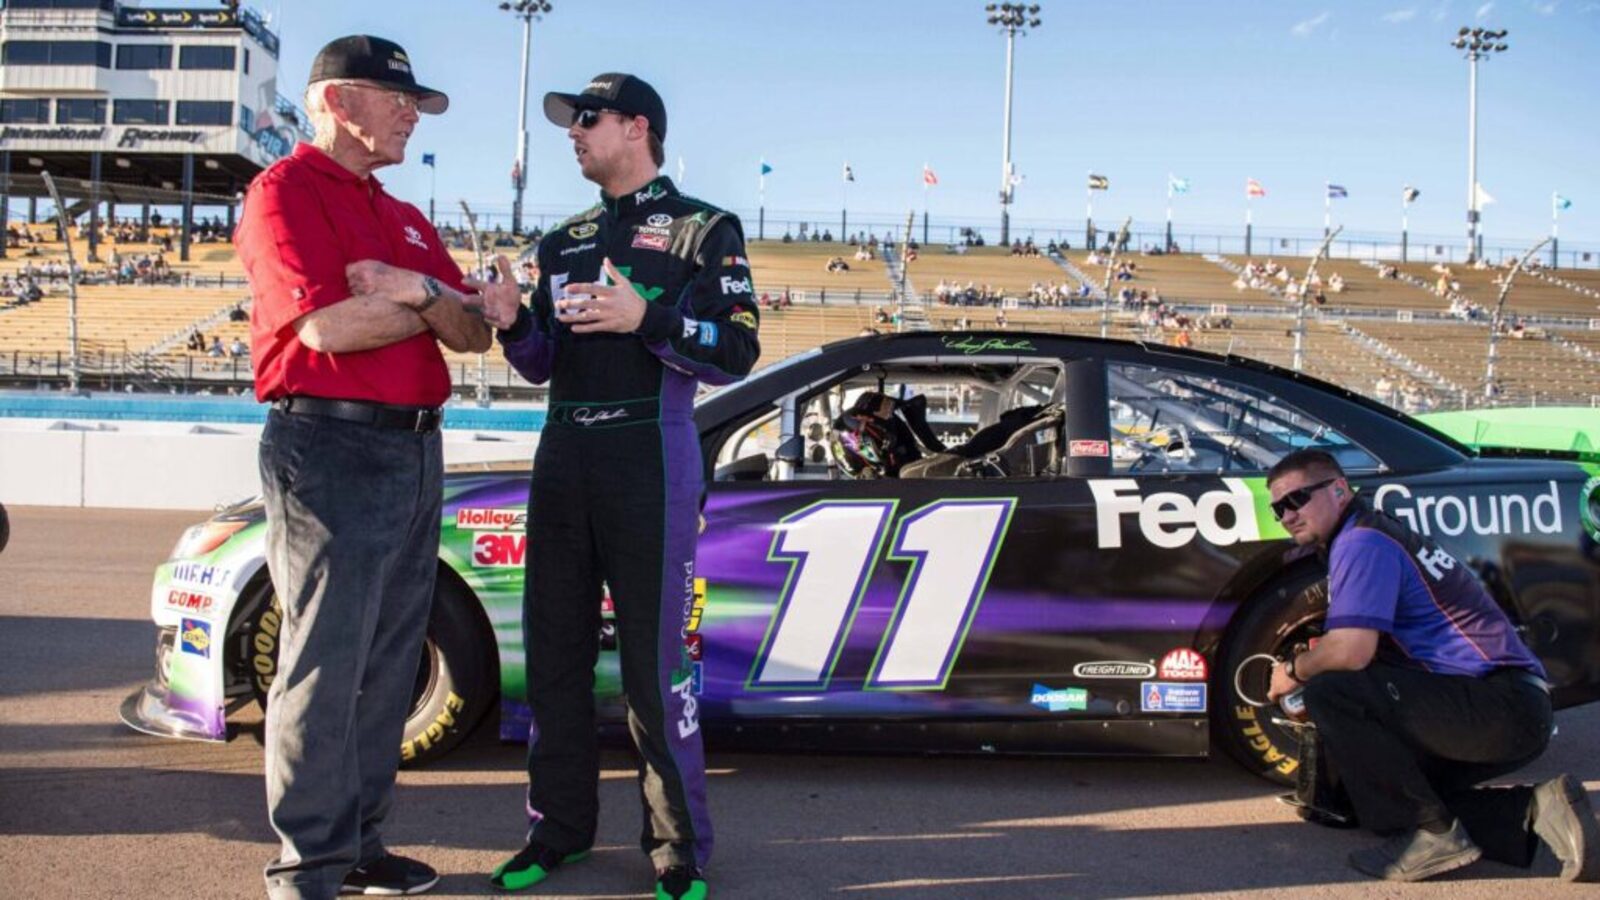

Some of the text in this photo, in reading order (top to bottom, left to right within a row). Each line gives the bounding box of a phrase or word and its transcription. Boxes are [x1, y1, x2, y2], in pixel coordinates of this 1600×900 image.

[1, 126, 202, 148] International Raceway
[720, 276, 753, 295] Fed
[458, 510, 513, 531] Holley
[1087, 477, 1563, 549] Fed Ground
[475, 534, 526, 565] 3M
[167, 590, 213, 608] COMP
[744, 497, 1018, 691] 11
[1080, 665, 1149, 675] FREIGHTLINER
[1161, 649, 1204, 670] MAC
[1163, 670, 1204, 679] TOOLS
[1031, 691, 1087, 704] DOOSAN
[400, 690, 465, 761] EAGLE
[1235, 705, 1300, 775] EAGLE
